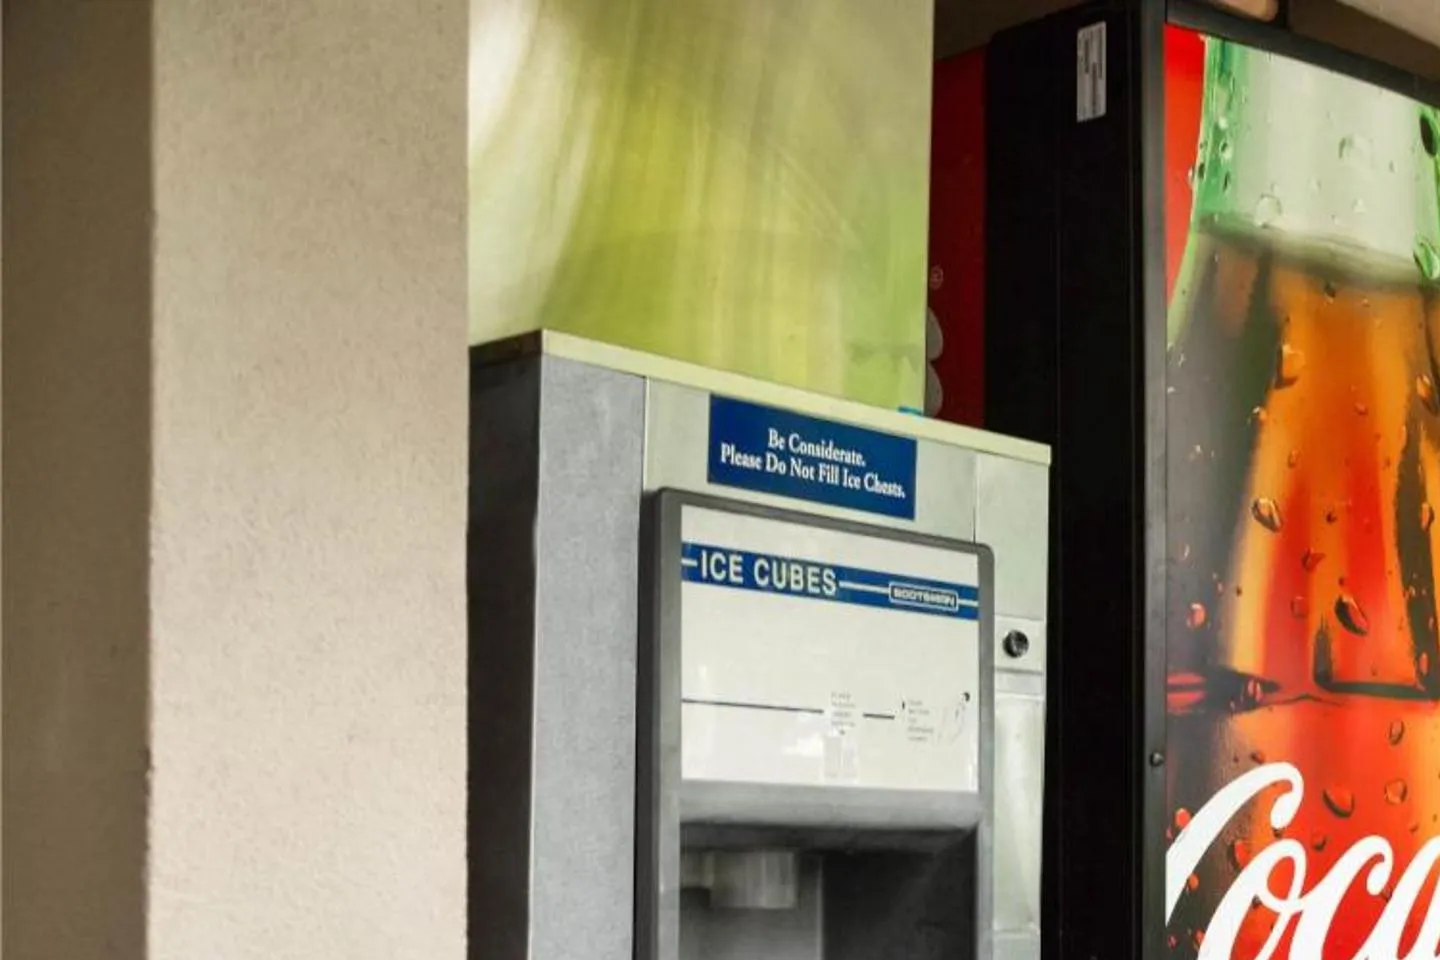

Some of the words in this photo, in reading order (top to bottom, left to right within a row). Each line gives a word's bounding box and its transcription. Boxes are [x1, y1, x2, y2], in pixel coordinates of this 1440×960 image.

[721, 442, 762, 470] Please
[766, 451, 786, 475] Do
[790, 457, 815, 480] Not
[819, 462, 840, 486] Fill
[843, 468, 860, 489] Ice
[864, 472, 906, 498] Chests.
[768, 427, 785, 451] Be
[788, 433, 866, 467] Considerate.
[701, 550, 743, 583] ICE
[754, 558, 836, 596] CUBES
